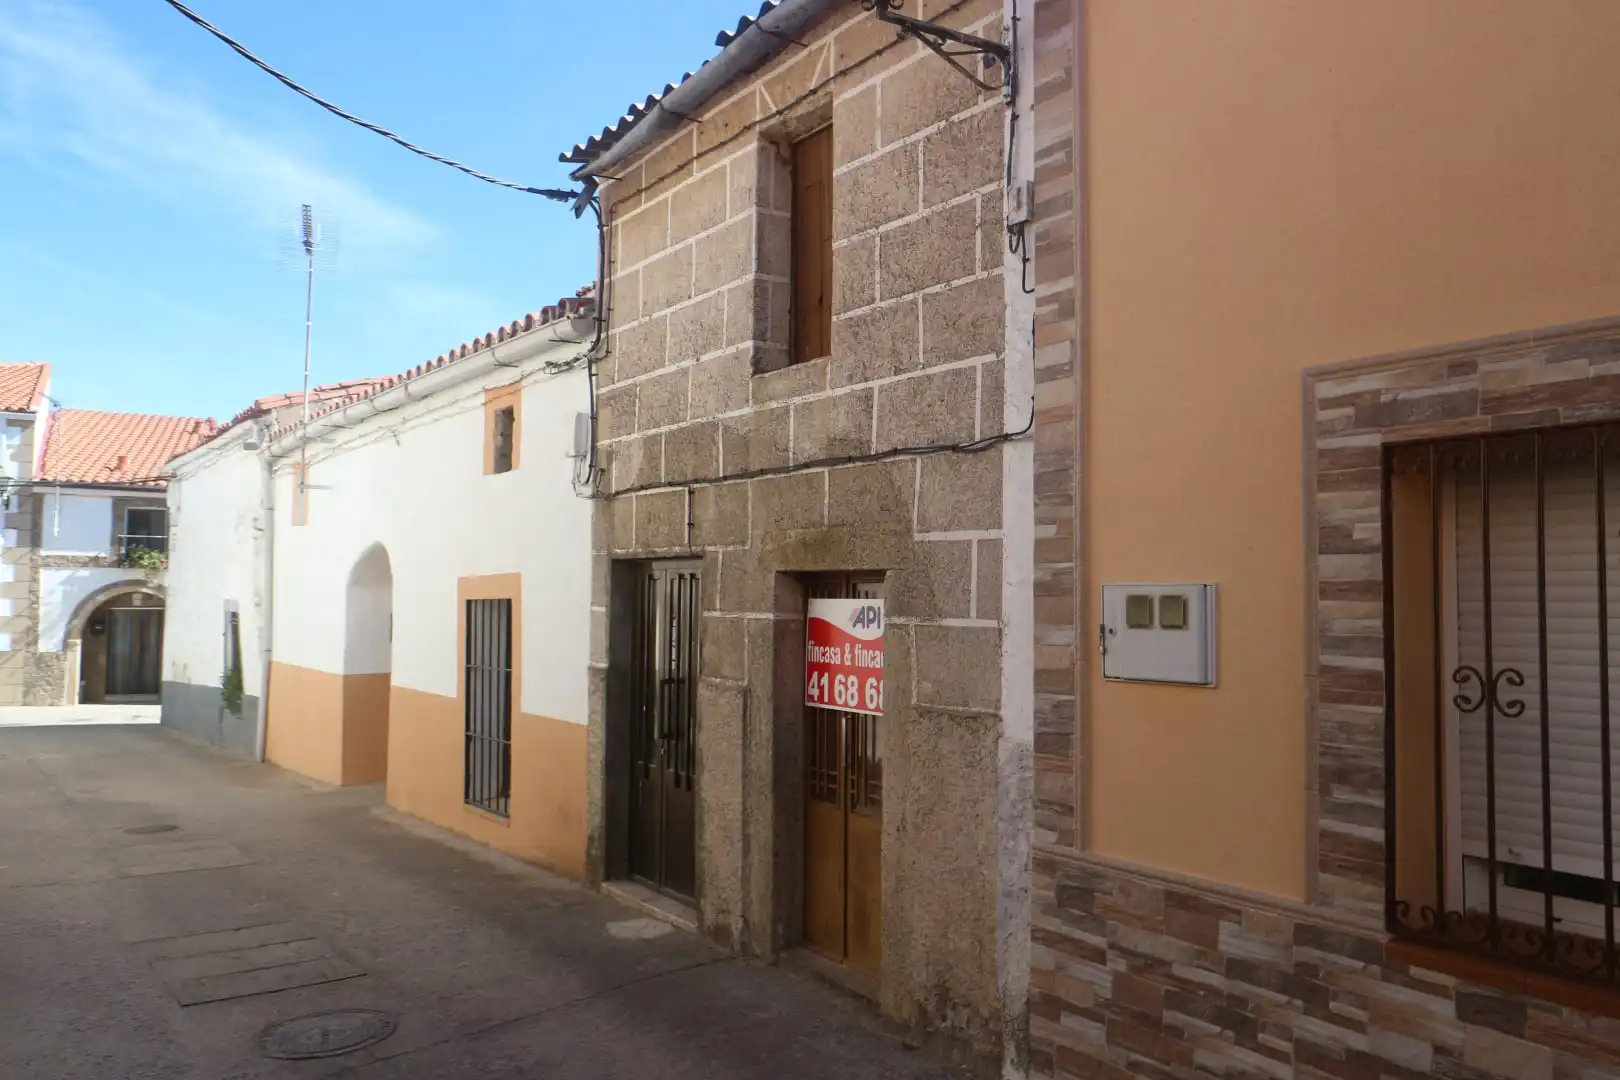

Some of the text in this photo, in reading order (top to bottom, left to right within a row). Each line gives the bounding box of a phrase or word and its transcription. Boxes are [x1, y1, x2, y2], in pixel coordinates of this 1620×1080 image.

[852, 606, 881, 629] API
[807, 641, 841, 665] fincasa
[844, 642, 852, 666] &
[807, 671, 829, 703] 41
[834, 674, 859, 707] 68
